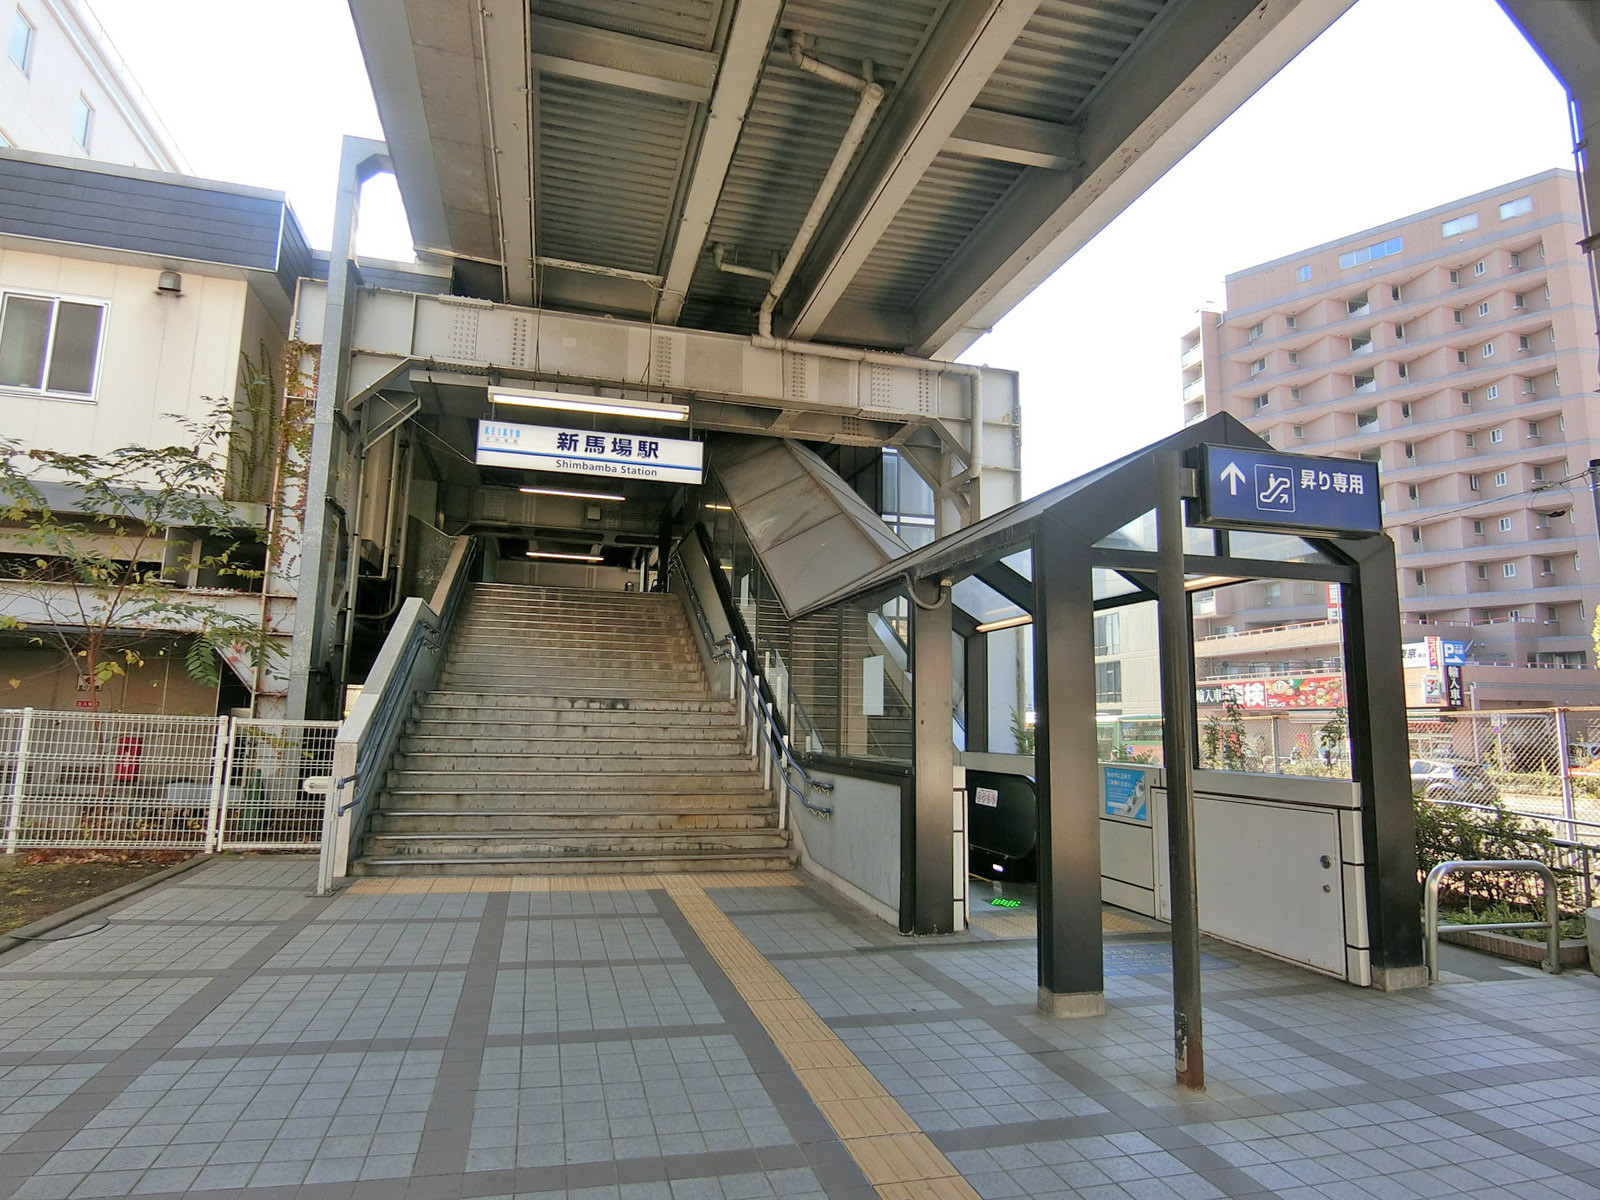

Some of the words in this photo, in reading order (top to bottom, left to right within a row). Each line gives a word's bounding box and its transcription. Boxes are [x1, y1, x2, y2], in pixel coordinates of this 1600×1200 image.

[557, 432, 660, 459] 新馬場駅
[556, 459, 618, 474] Shimbamba
[620, 465, 658, 477] Station
[1300, 469, 1365, 495] 昇り専用
[1444, 643, 1454, 657] P
